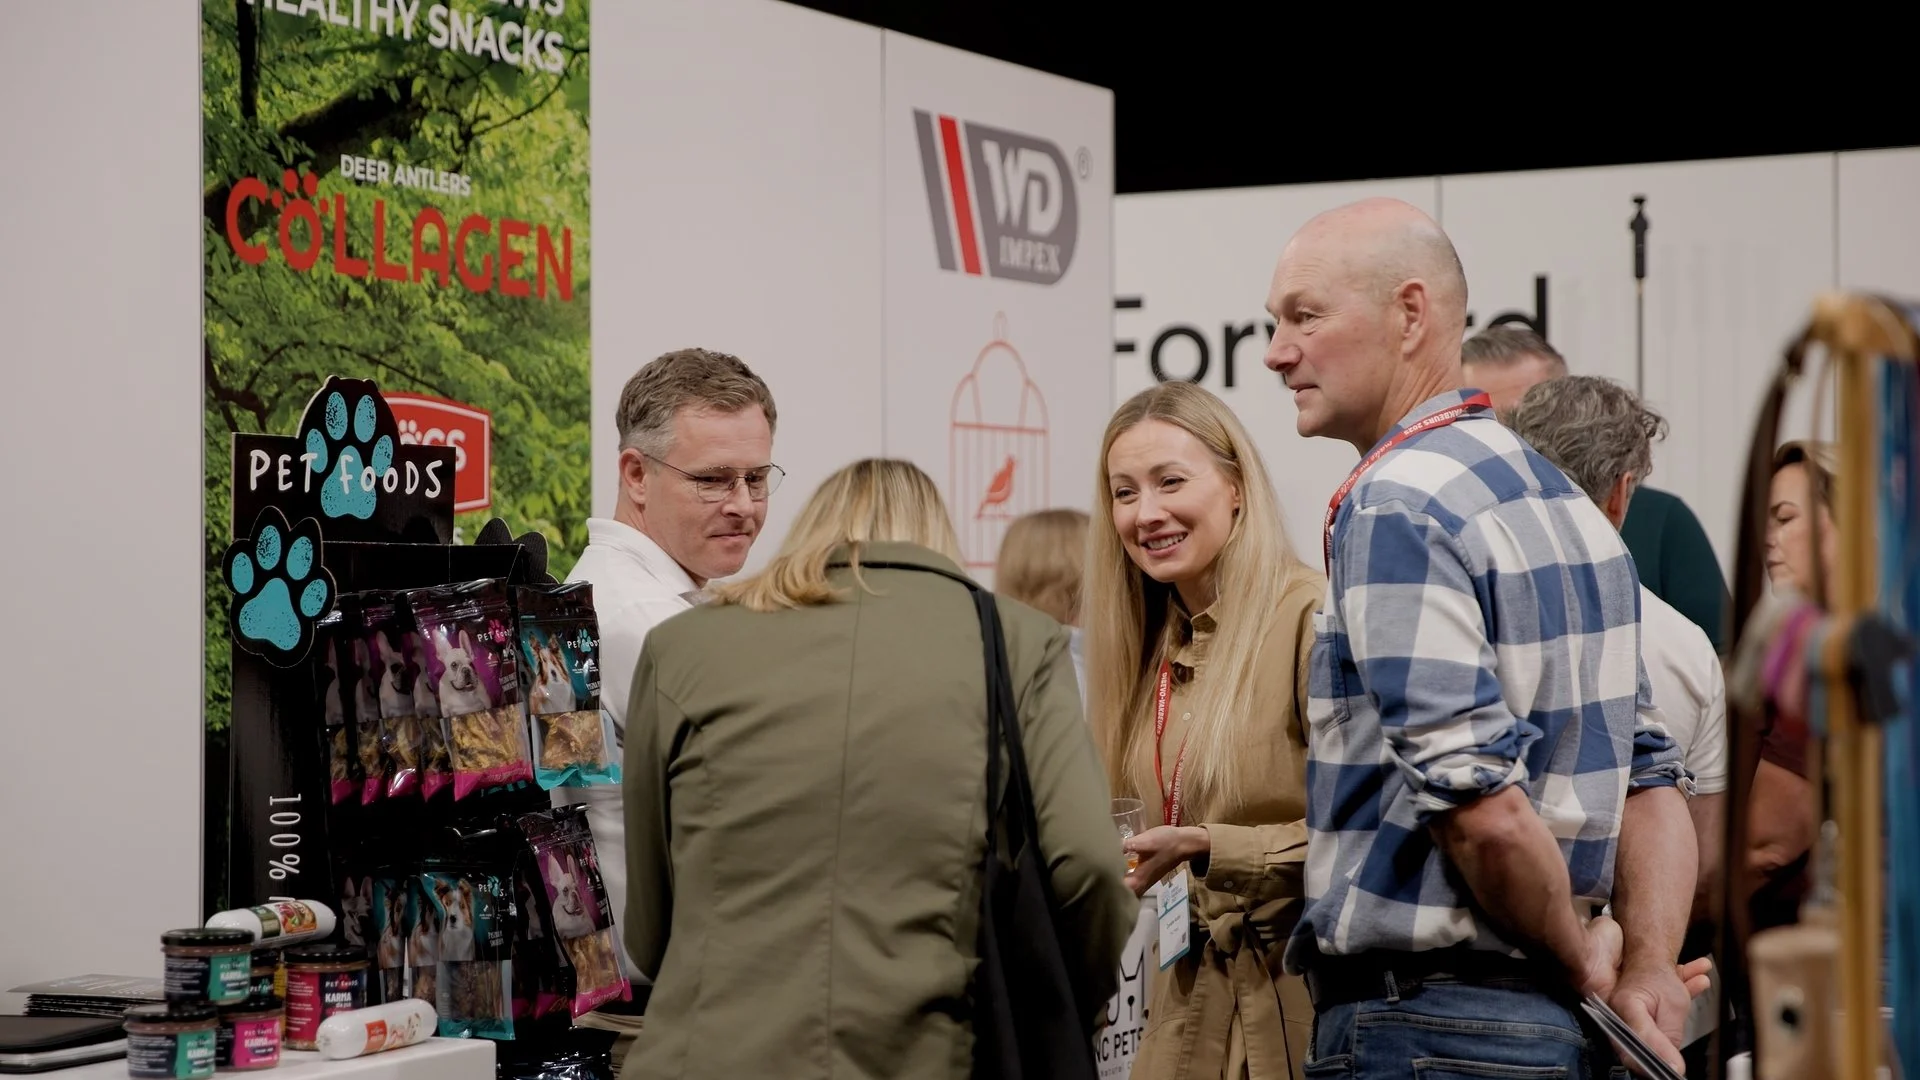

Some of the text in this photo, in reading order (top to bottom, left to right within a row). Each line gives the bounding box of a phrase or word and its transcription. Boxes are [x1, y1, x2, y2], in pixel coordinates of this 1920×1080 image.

[427, 3, 565, 74] SNACKS
[340, 154, 472, 197] DEER ANTLERS
[998, 234, 1062, 275] IMPEX
[250, 449, 318, 493] PET
[476, 631, 493, 643] PET
[268, 793, 302, 880] 100%
[325, 992, 352, 1003] KARMA
